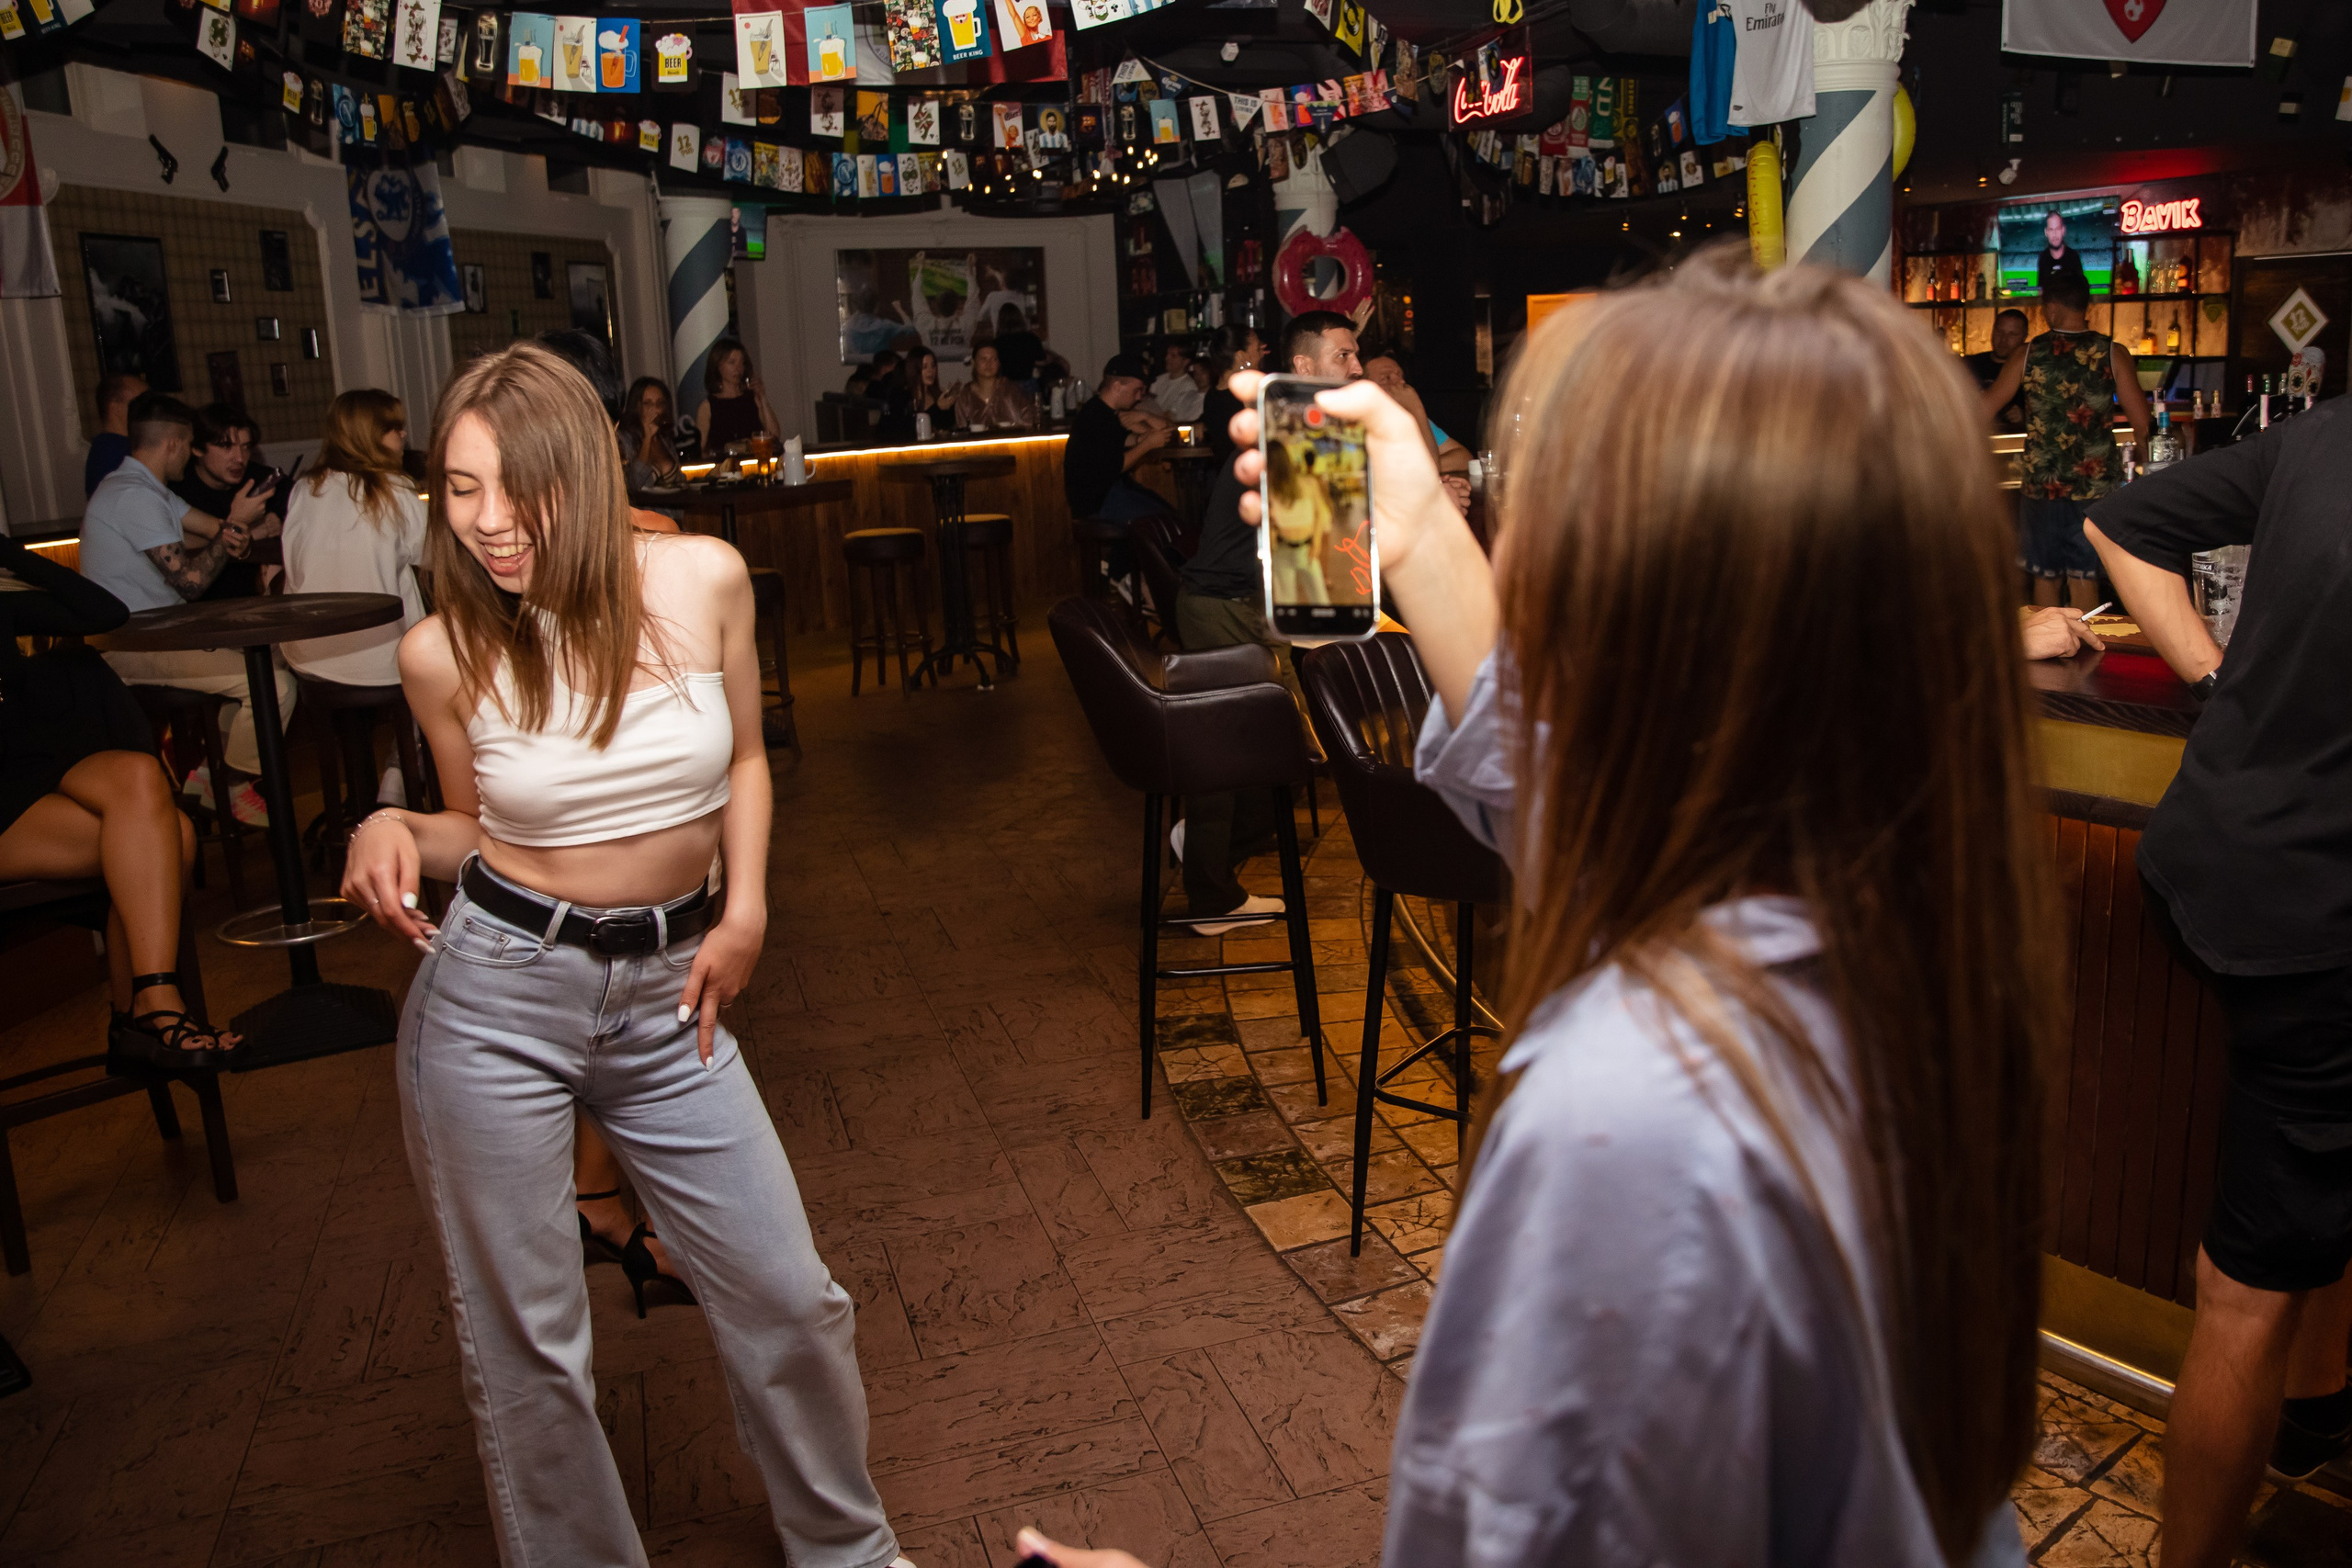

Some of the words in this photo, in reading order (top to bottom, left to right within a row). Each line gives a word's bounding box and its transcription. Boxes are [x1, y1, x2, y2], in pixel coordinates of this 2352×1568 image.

[1764, 3, 1776, 14] Fly
[953, 53, 967, 62] BEER
[968, 49, 983, 57] KING
[665, 58, 682, 68] BEER
[2120, 197, 2202, 234] BAVIK
